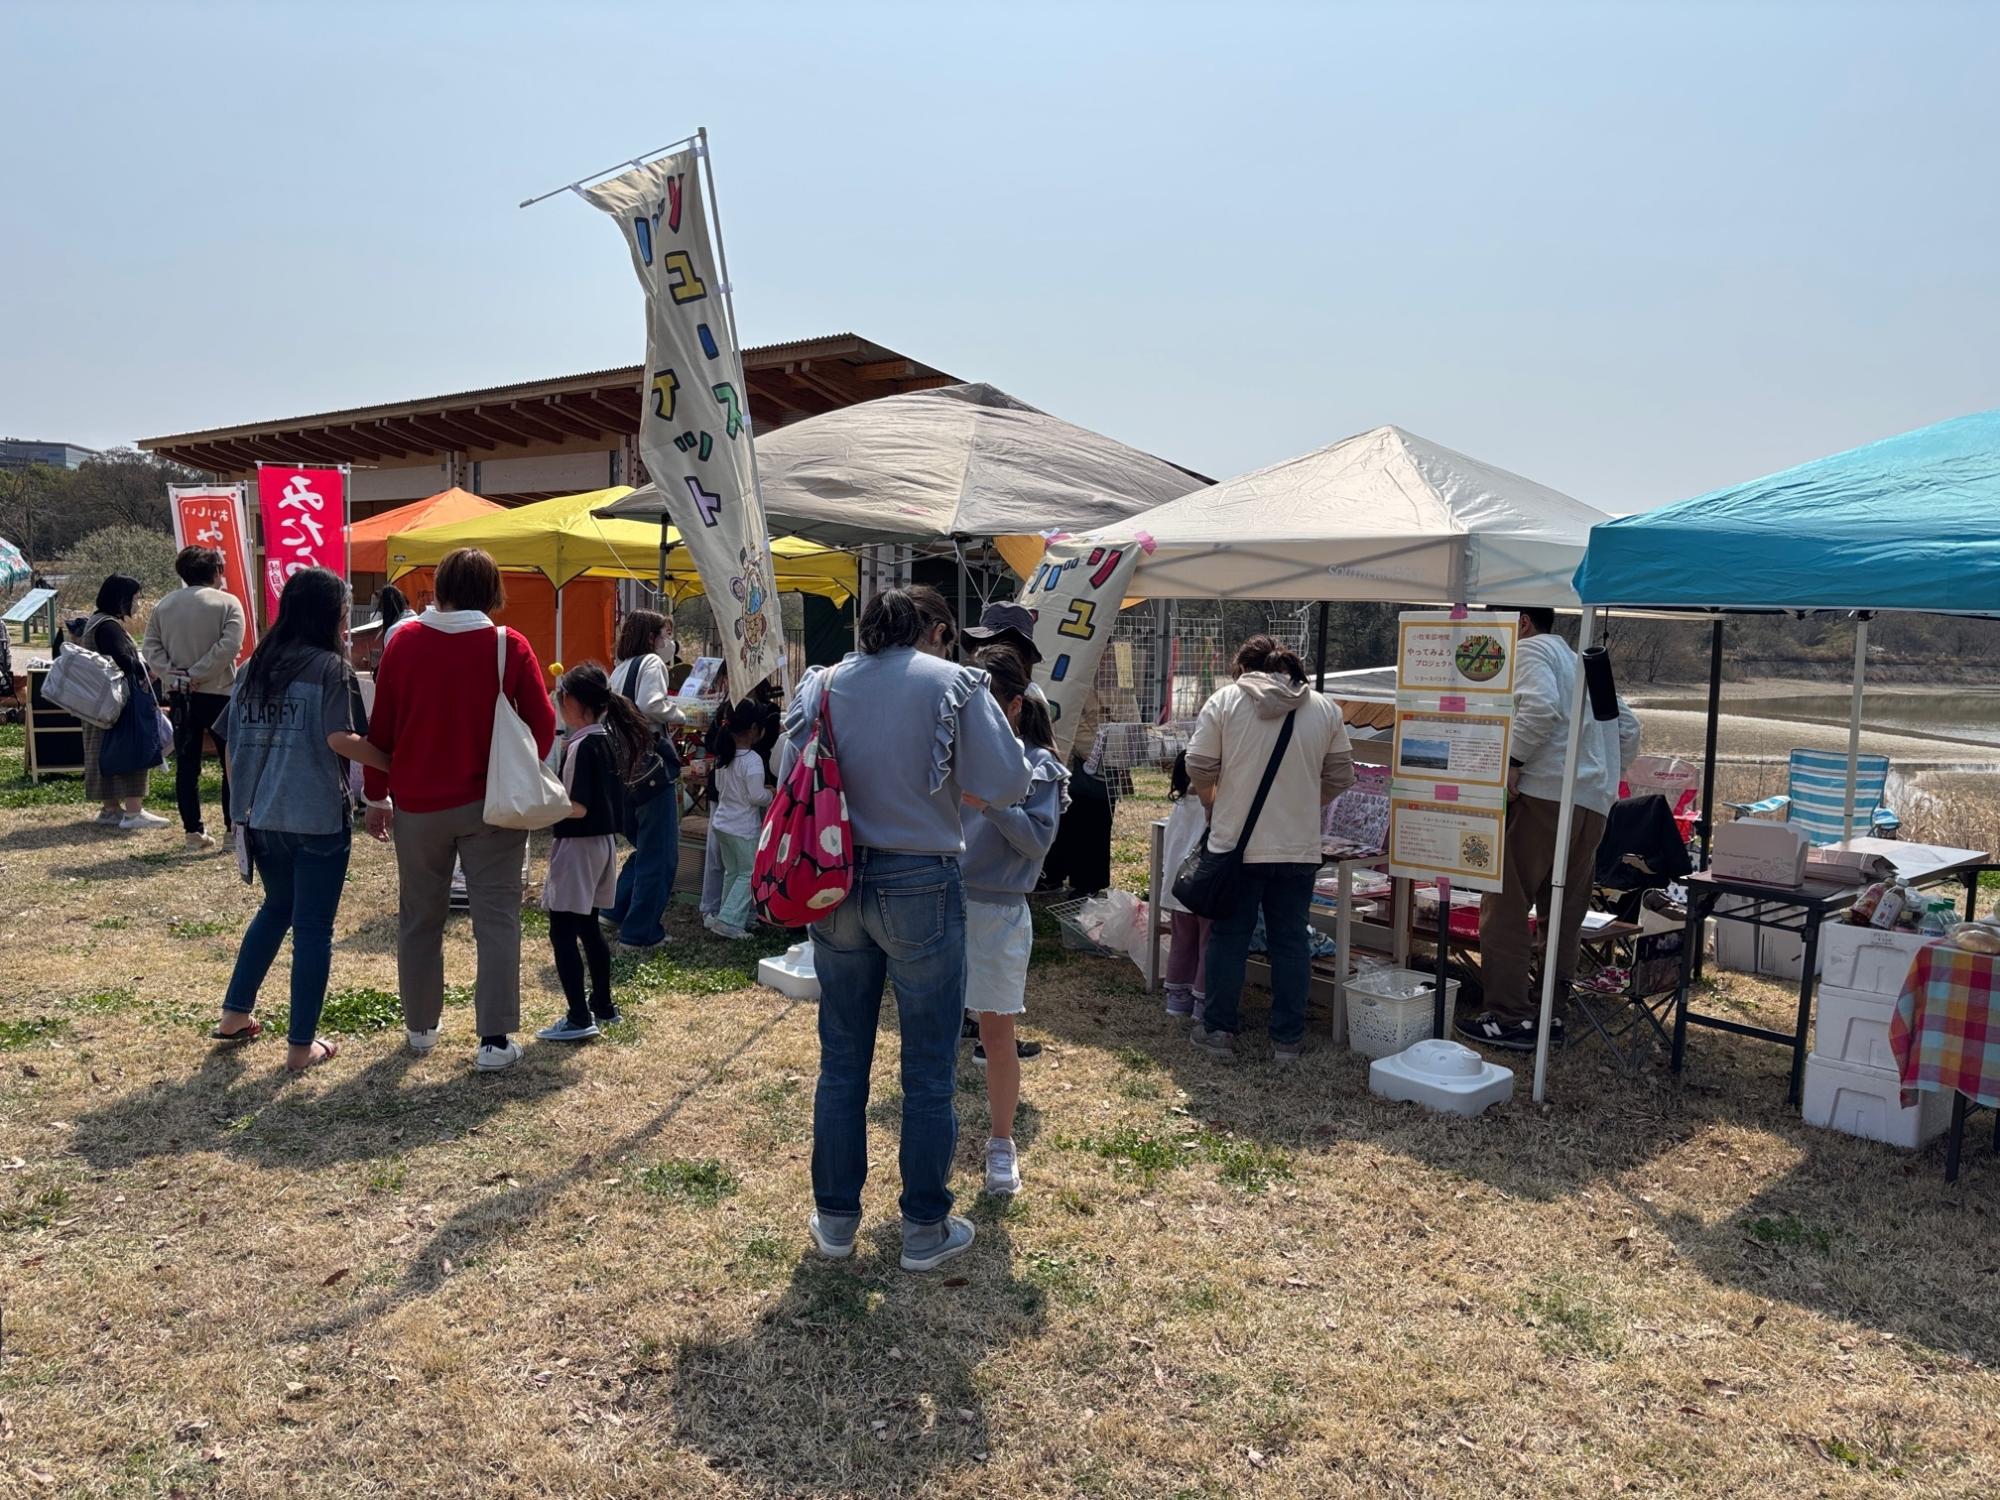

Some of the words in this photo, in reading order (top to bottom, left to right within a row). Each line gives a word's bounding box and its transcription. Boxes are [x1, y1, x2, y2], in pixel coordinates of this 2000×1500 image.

[1407, 648, 1452, 657] やってみよう
[1415, 659, 1454, 668] プロジェクト
